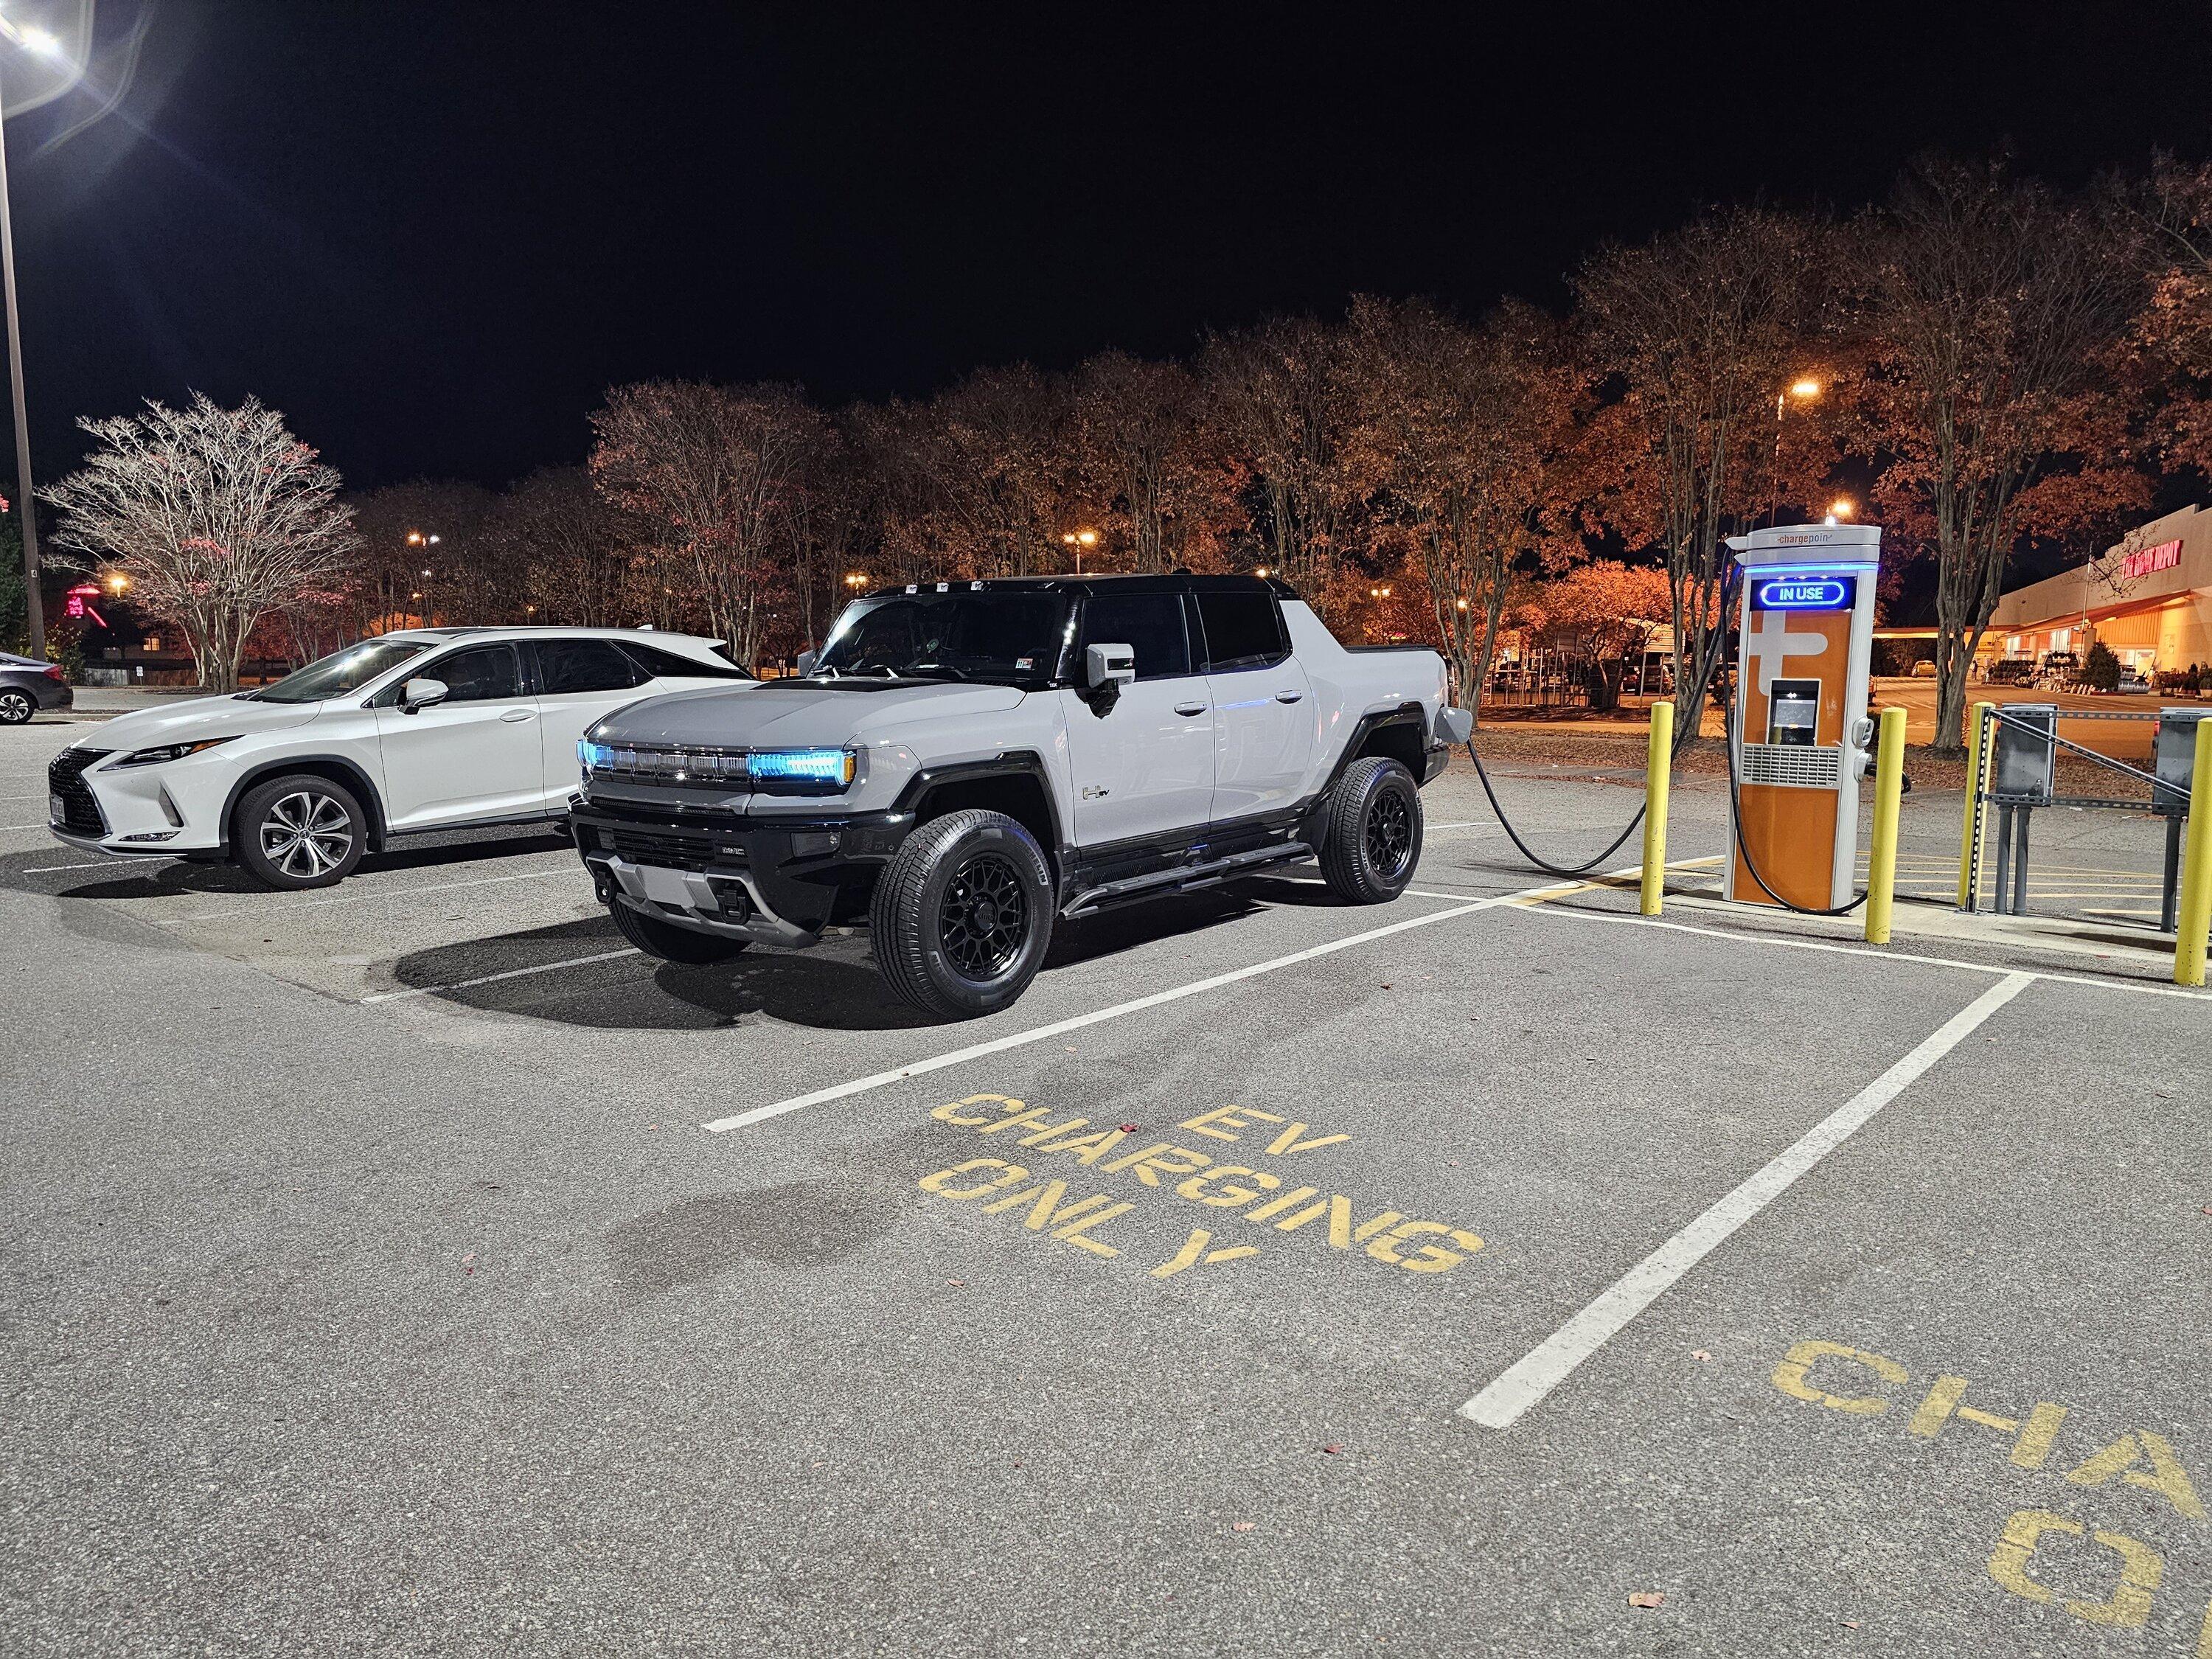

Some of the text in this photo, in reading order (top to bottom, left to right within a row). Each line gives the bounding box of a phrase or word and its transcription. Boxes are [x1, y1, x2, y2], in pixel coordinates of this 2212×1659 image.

[1779, 587, 1823, 600] IN USE
[2153, 539, 2181, 571] DEPOT
[722, 846, 745, 855] GMC
[1180, 1105, 1352, 1155] EV
[919, 1158, 1261, 1279] ONLY
[930, 1093, 1485, 1273] CHARGING
[1771, 1340, 2209, 1520] CHA
[1987, 1510, 2212, 1659] O
